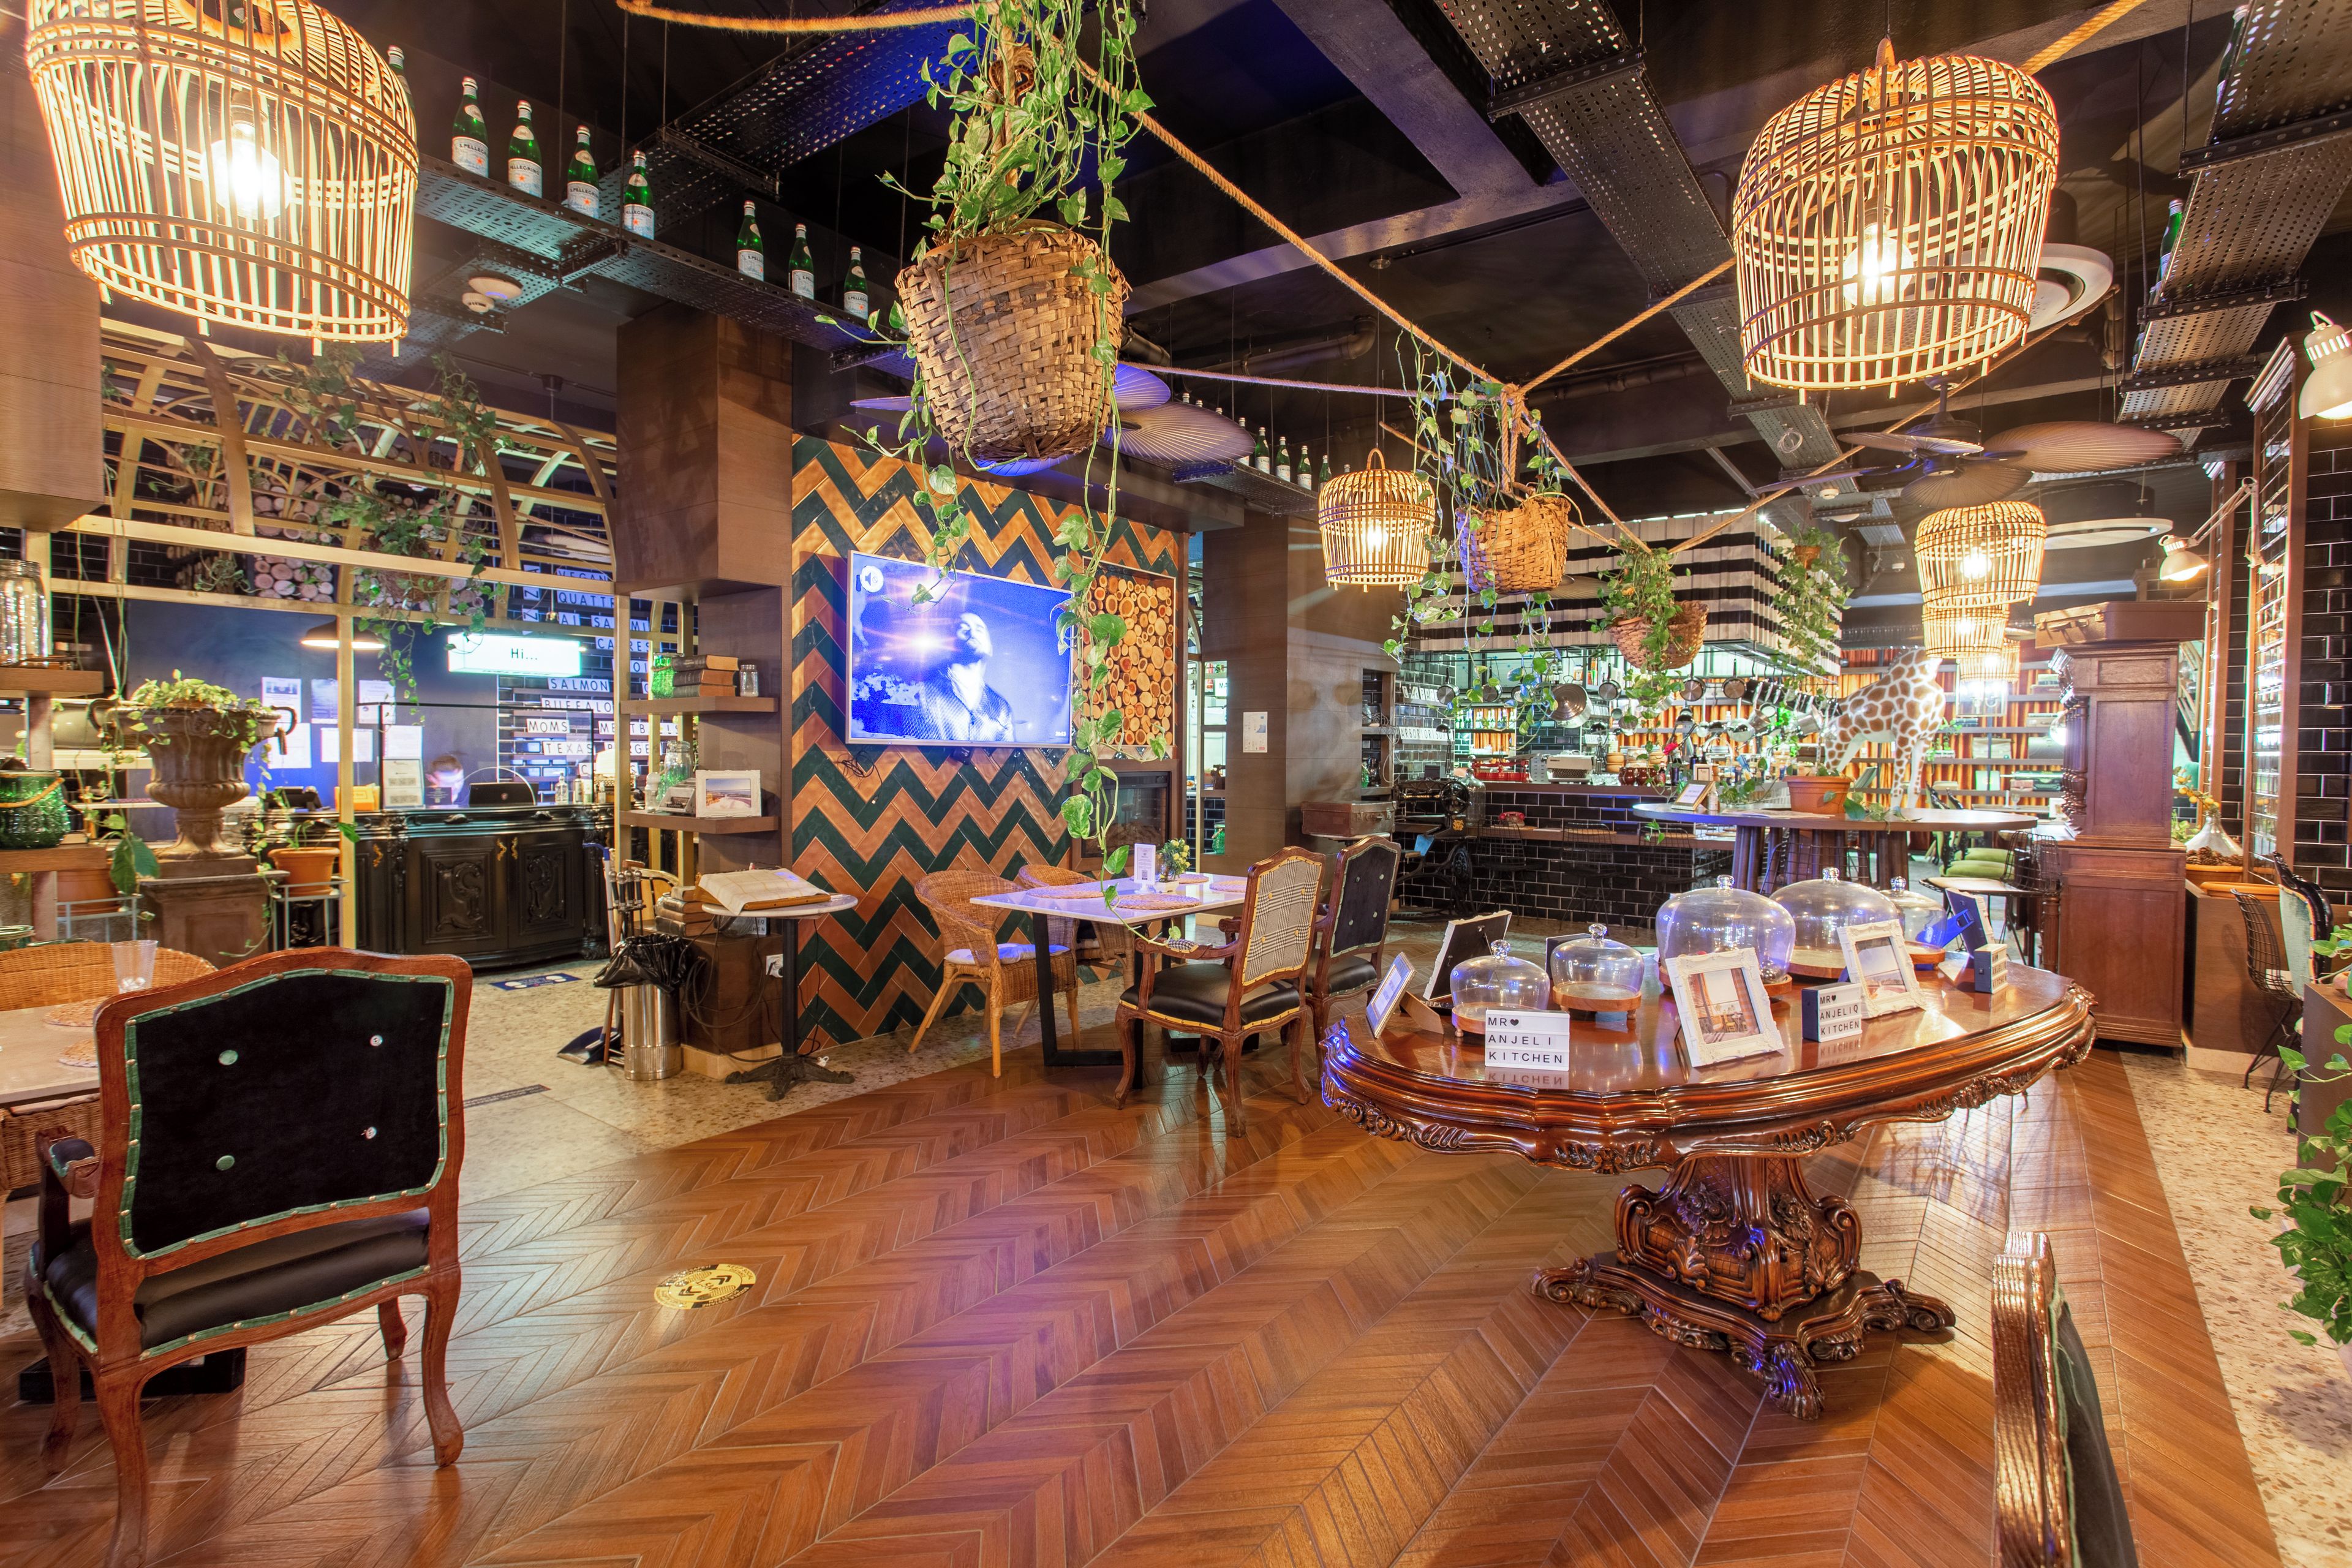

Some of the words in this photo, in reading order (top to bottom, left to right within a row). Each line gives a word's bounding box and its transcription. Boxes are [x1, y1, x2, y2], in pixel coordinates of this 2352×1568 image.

[594, 617, 646, 631] SAMI
[551, 678, 608, 691] SALMON
[528, 720, 568, 733] MOMS
[546, 743, 592, 754] TEXAS
[1820, 995, 1831, 1005] MR
[1820, 1004, 1858, 1021] ANJELIQ
[1488, 1017, 1507, 1027] MR
[1820, 1020, 1860, 1036] KITCHEN
[1488, 1035, 1551, 1046] ANJELI
[1488, 1051, 1562, 1063] KITCHEN
